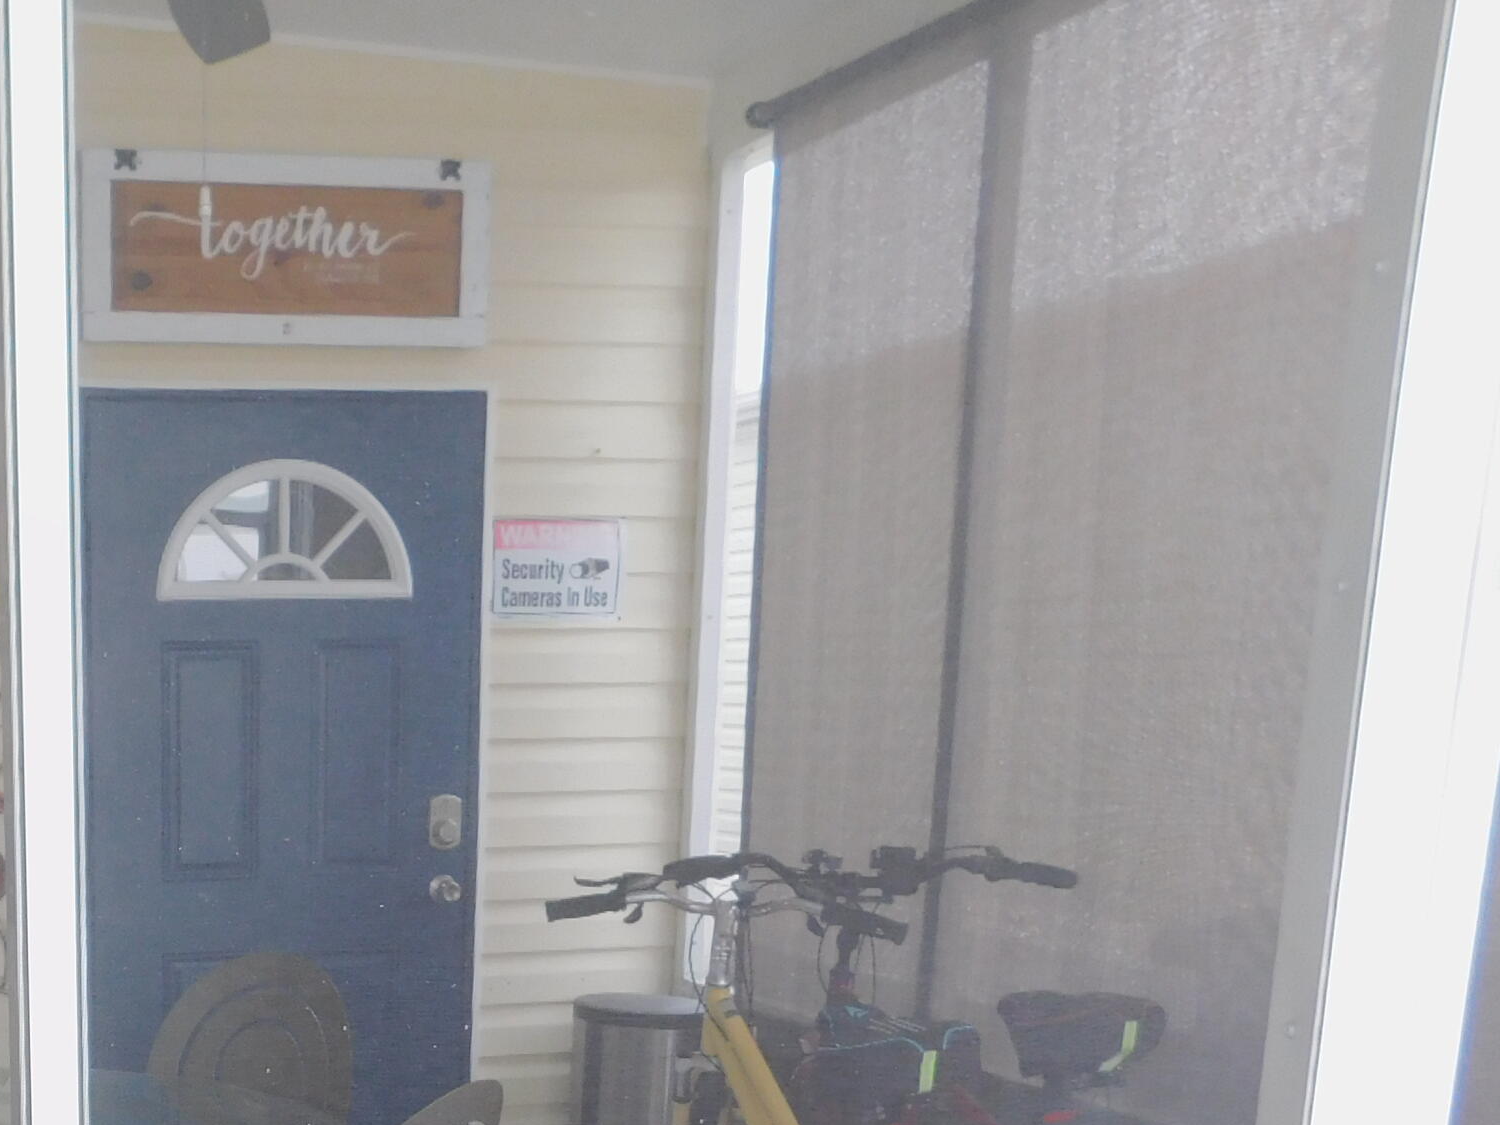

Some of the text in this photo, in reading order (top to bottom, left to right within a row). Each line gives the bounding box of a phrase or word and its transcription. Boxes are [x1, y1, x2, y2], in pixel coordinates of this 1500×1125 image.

[129, 195, 416, 281] together
[502, 558, 564, 584] Security
[502, 586, 562, 608] Cameras
[584, 585, 608, 607] Use
